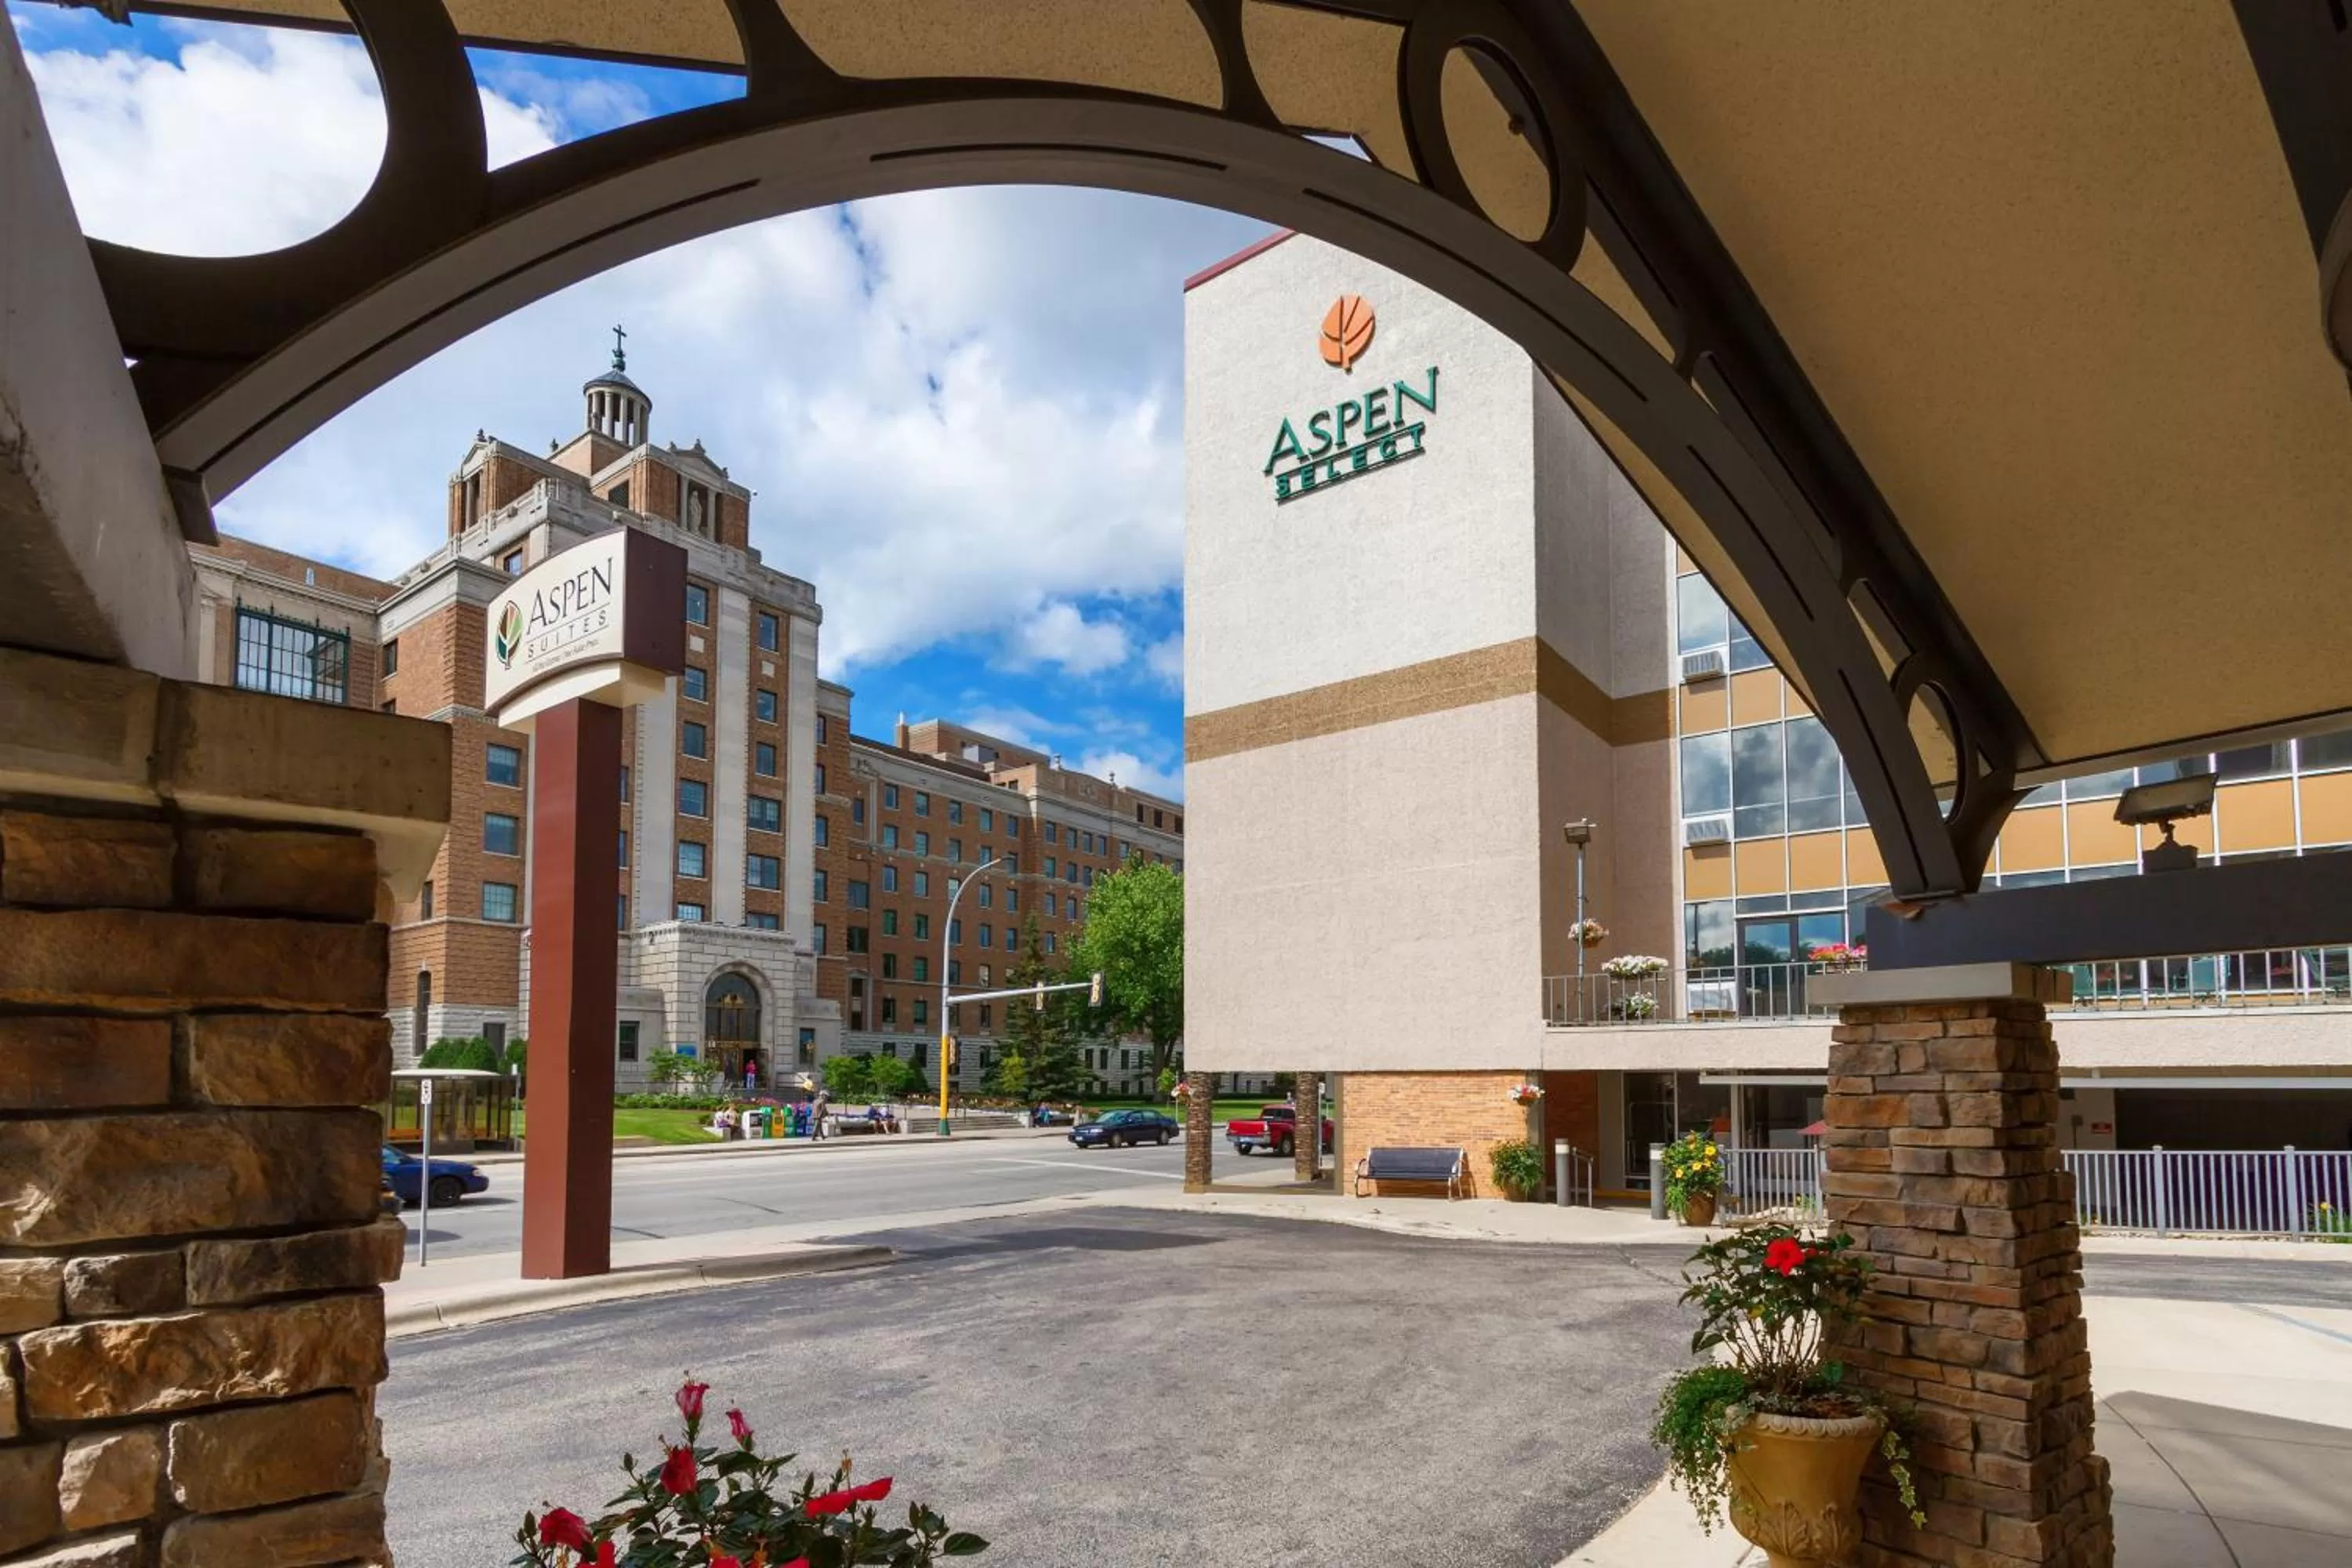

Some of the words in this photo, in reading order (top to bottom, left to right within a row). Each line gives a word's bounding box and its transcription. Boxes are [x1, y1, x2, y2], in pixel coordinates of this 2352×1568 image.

[1263, 365, 1439, 477] ASPEN
[1276, 425, 1424, 495] SELECT
[526, 556, 613, 636] ASPEN
[528, 609, 607, 658] SUITES
